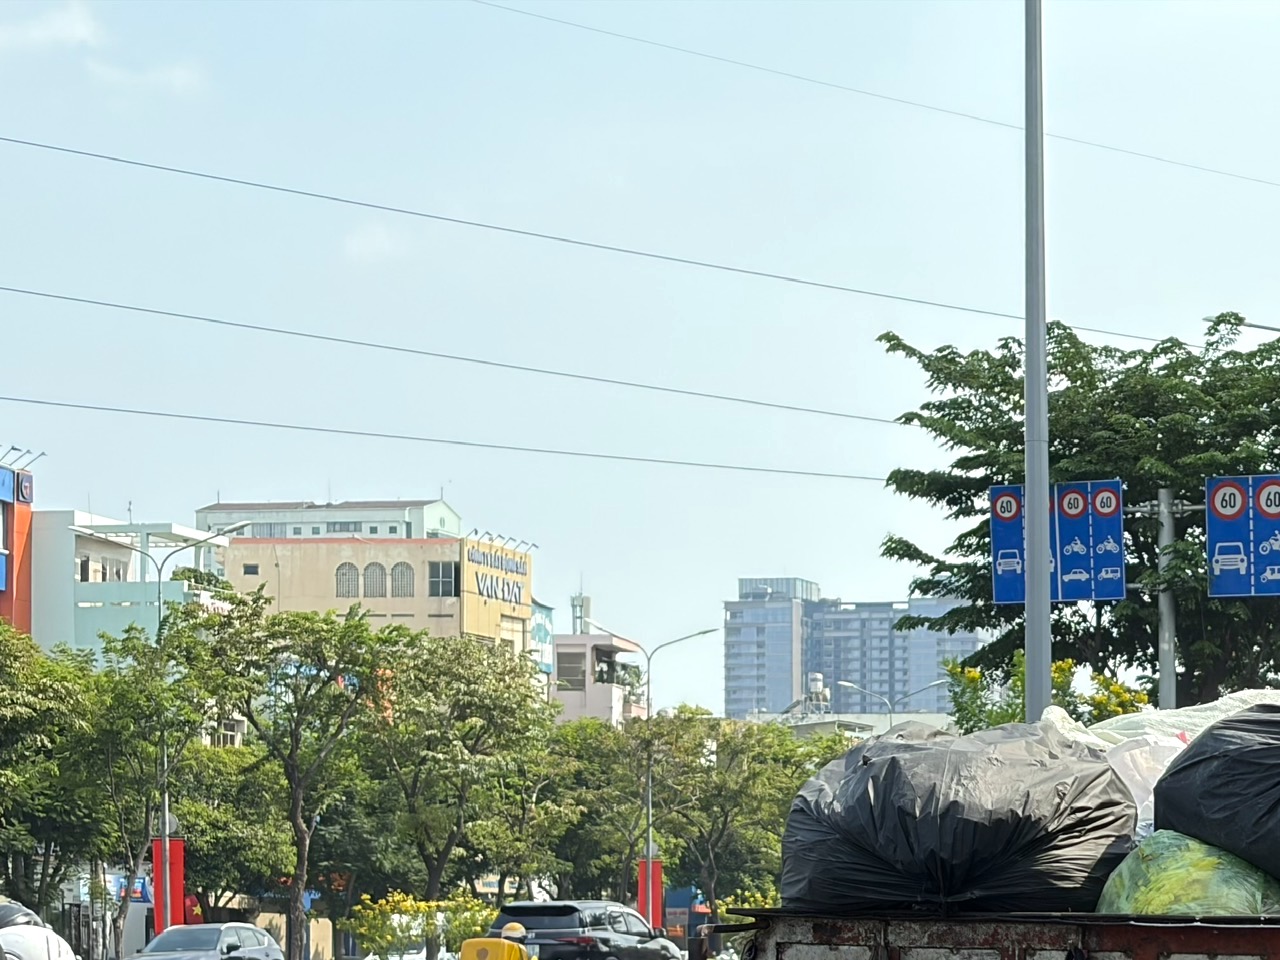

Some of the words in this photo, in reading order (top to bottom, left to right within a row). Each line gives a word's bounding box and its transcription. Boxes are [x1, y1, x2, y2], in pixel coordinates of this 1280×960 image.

[1067, 497, 1079, 510] 60
[1100, 496, 1112, 509] 60
[1220, 492, 1236, 509] 60
[1265, 491, 1280, 508] 60
[1000, 500, 1012, 514] 60
